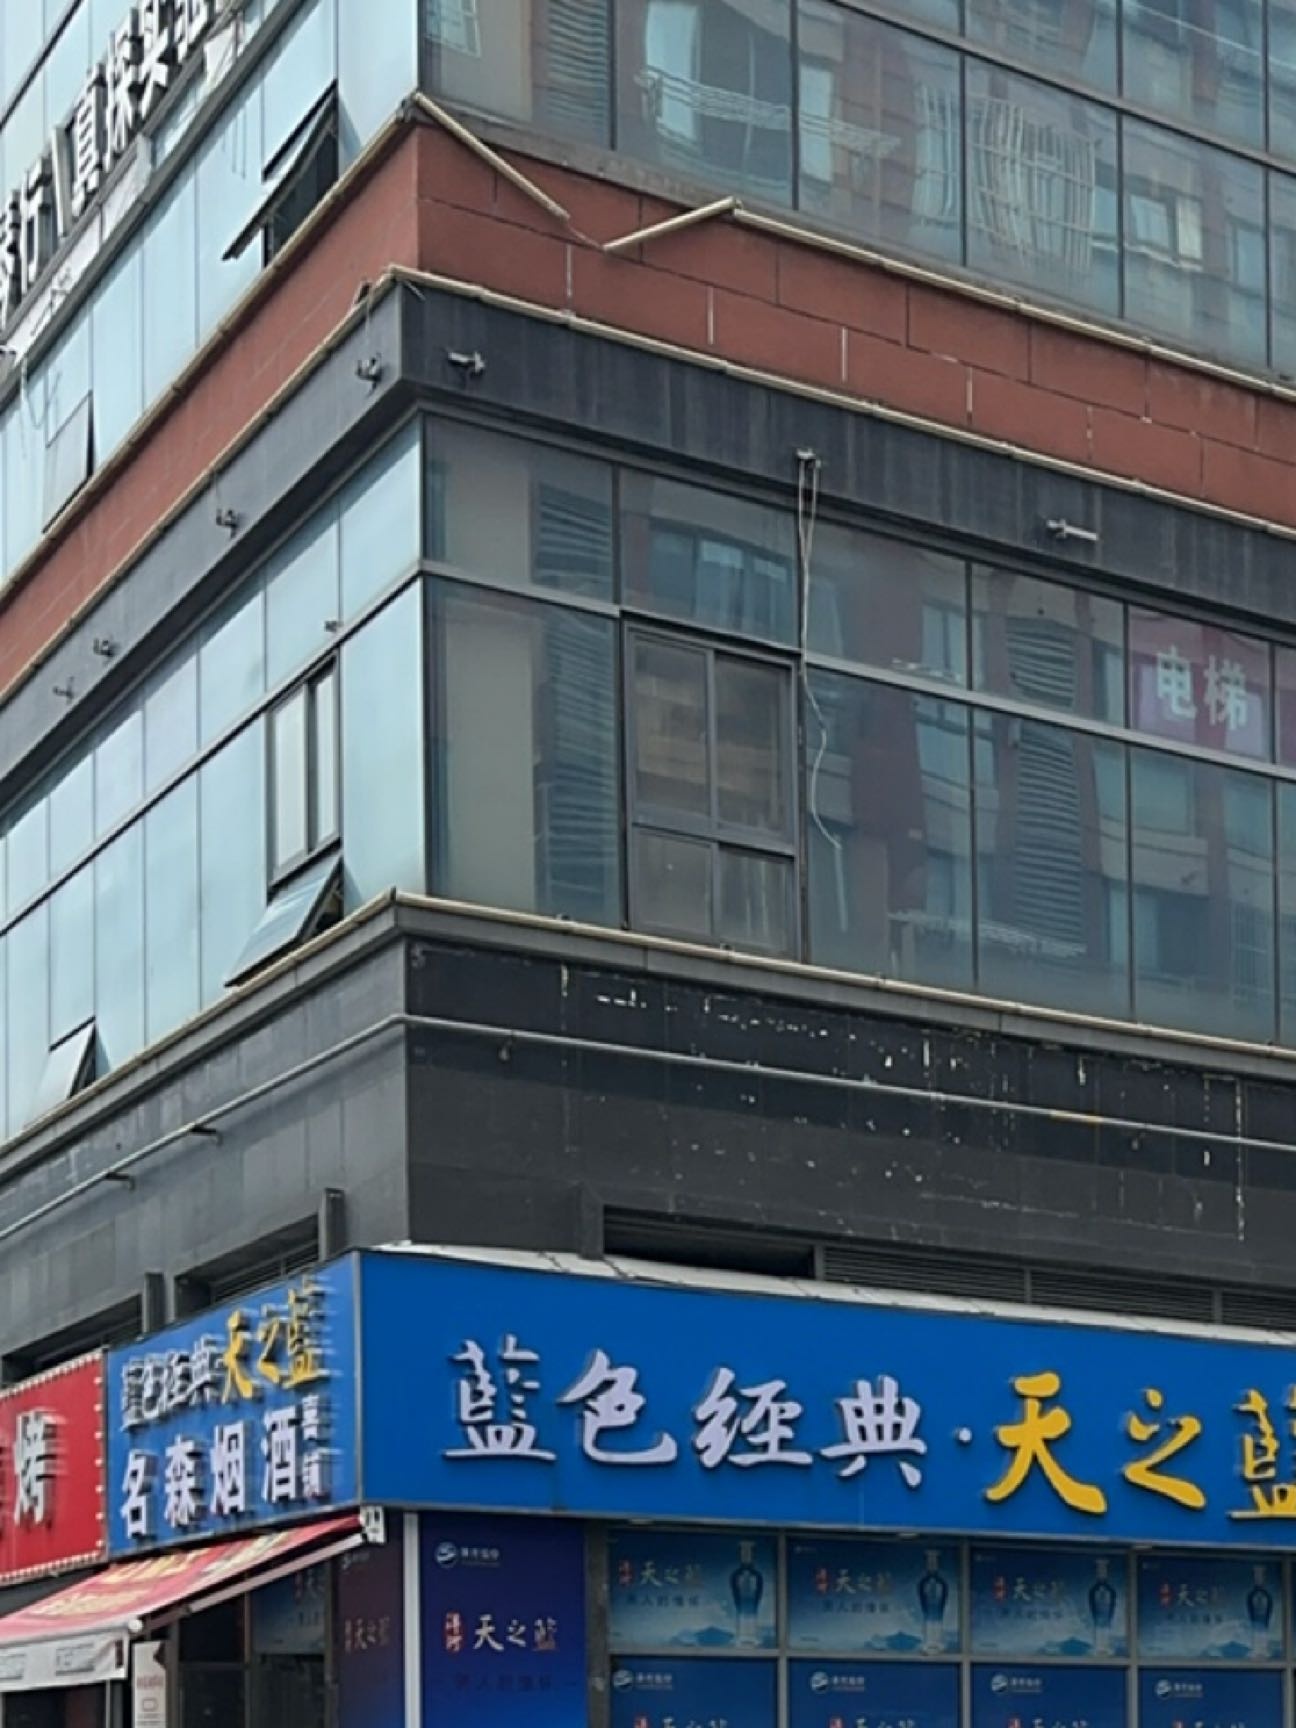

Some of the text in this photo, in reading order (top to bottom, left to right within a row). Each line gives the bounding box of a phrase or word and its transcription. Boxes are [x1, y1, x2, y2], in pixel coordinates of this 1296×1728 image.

[1157, 645, 1248, 731] 电梯
[120, 1404, 303, 1540] 名森烟酒
